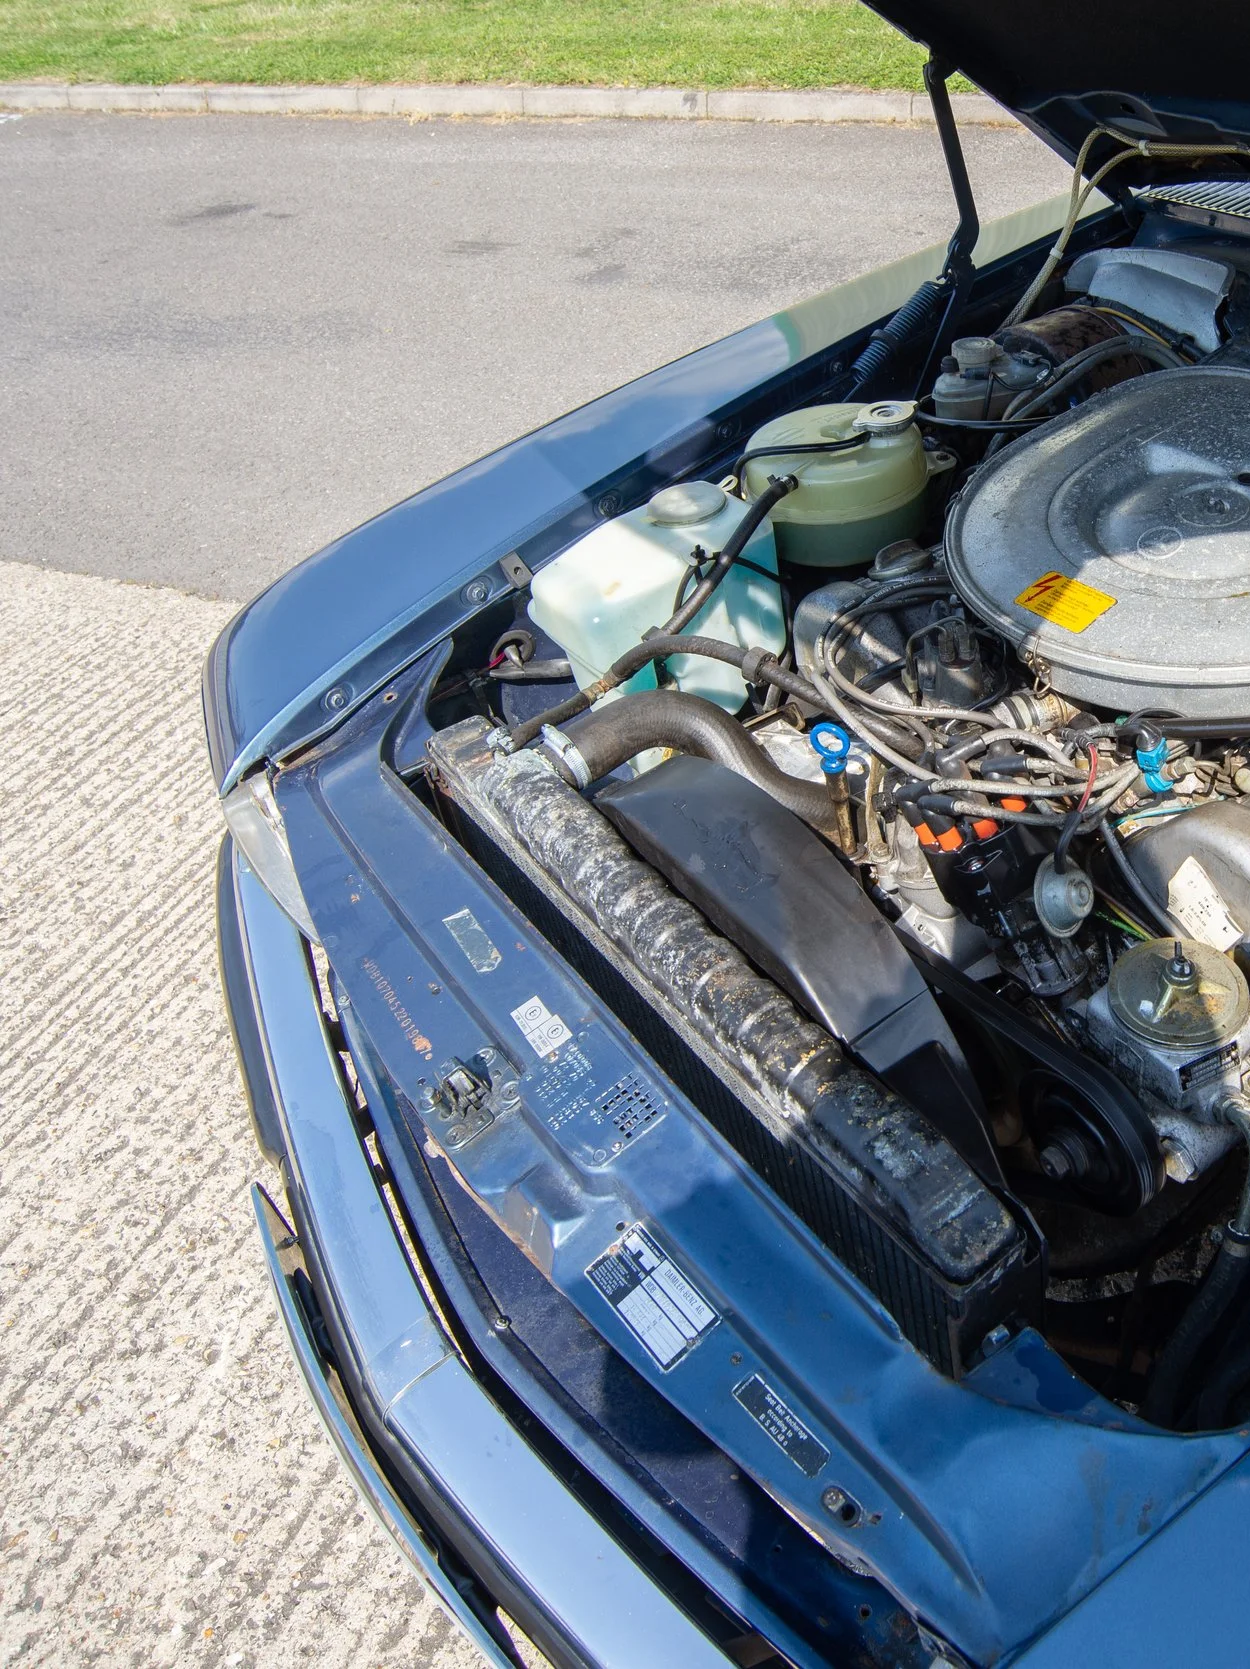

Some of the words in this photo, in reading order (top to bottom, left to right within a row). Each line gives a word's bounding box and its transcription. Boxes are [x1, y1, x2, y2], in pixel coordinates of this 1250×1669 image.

[645, 1281, 656, 1294] WDB
[664, 1269, 698, 1307] DAIMLER-BENZ
[765, 1394, 777, 1407] Seat
[775, 1404, 785, 1417] Belt
[784, 1415, 808, 1440] Anchorage
[767, 1409, 787, 1433] according
[786, 1429, 793, 1438] to
[769, 1426, 779, 1435] AU
